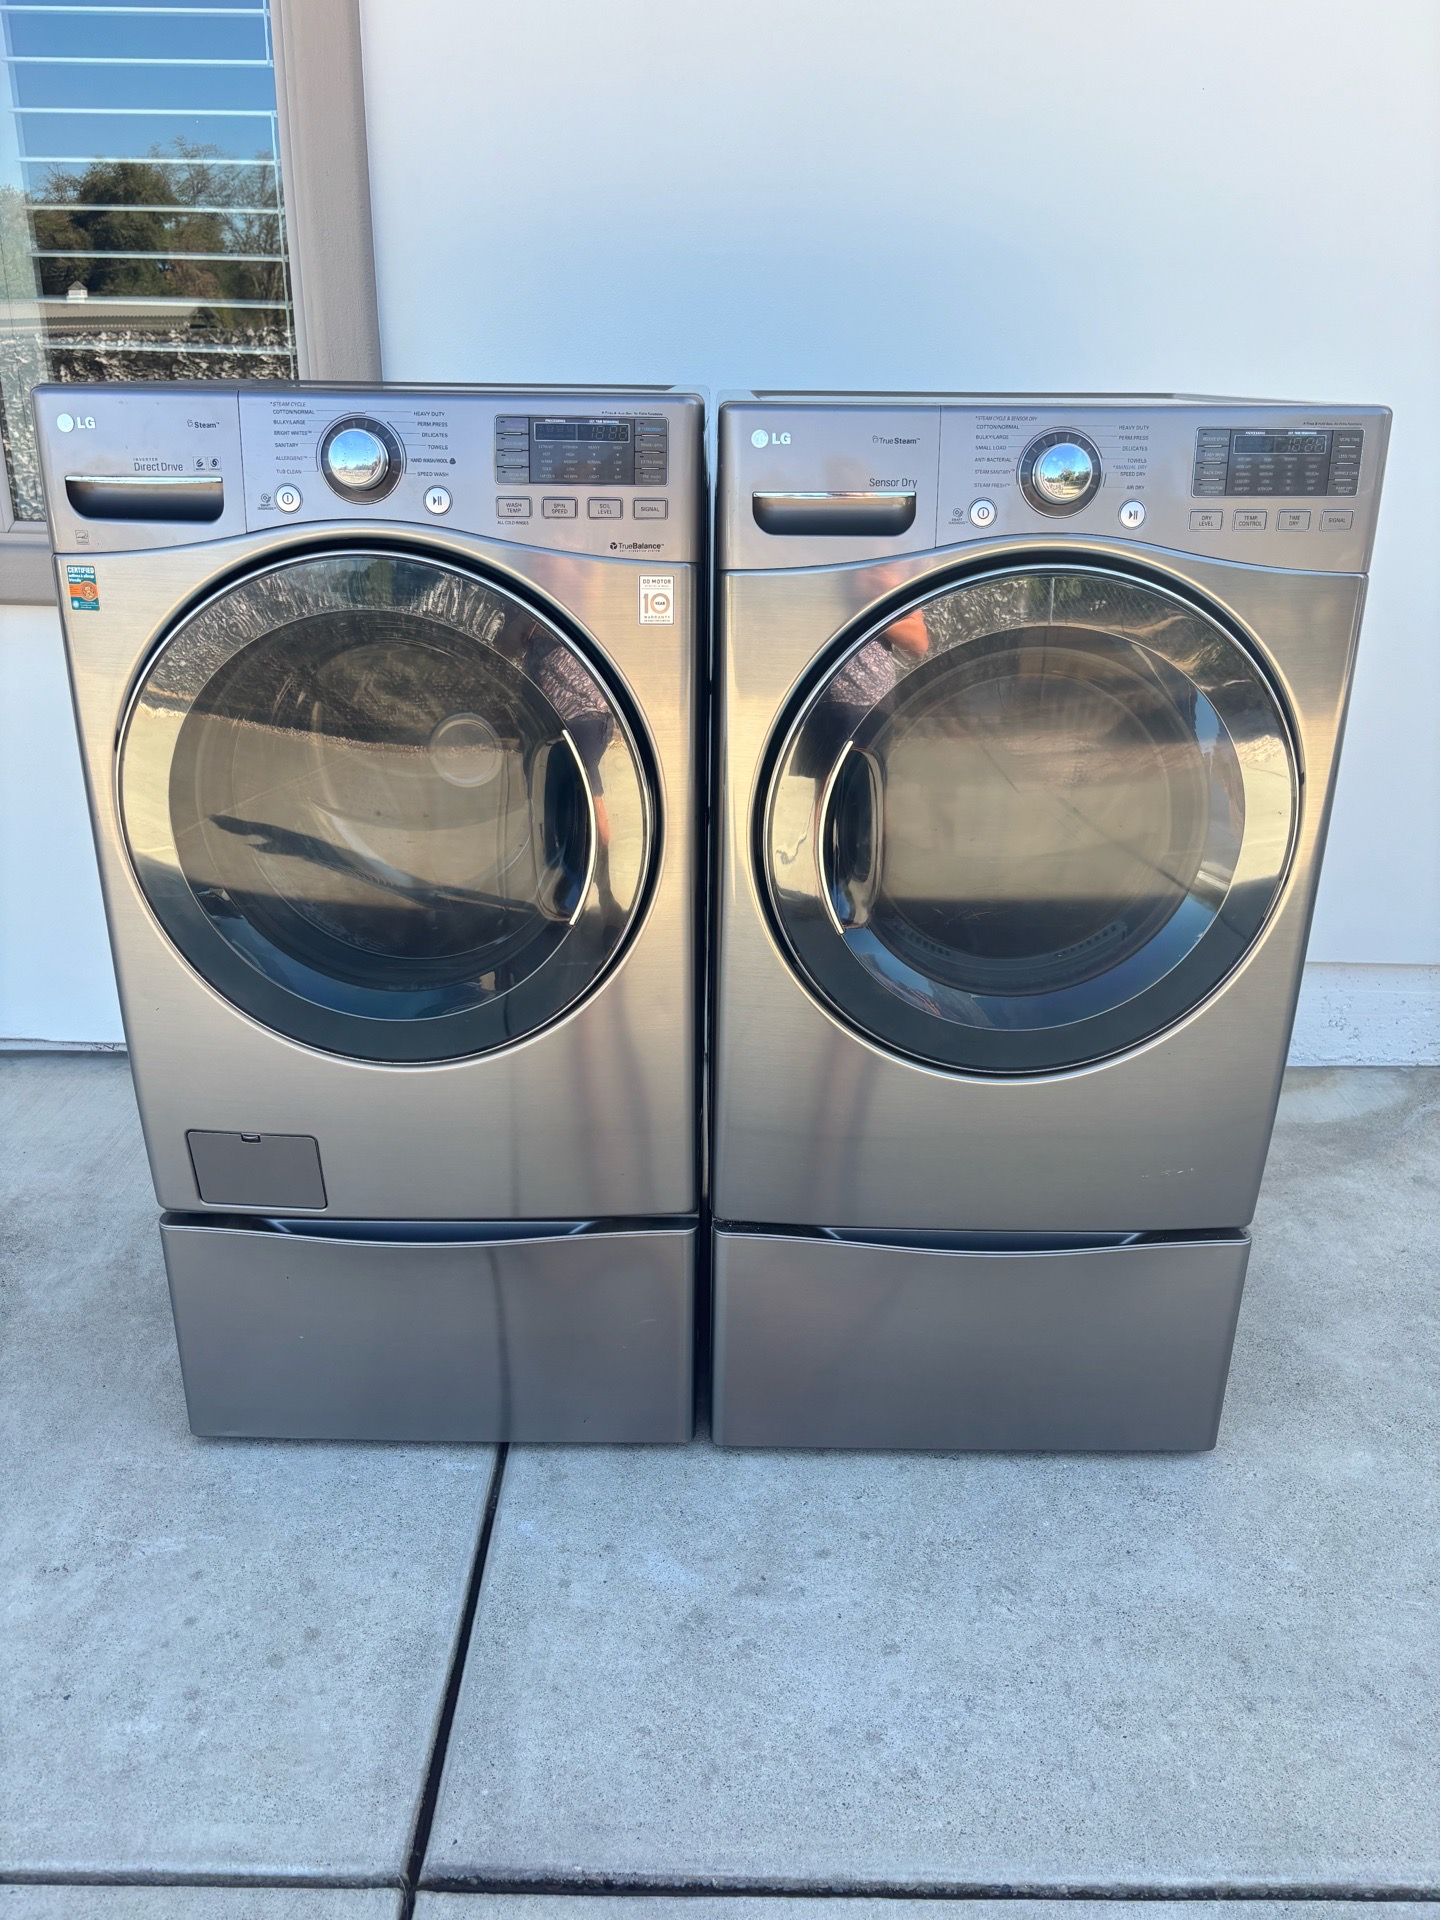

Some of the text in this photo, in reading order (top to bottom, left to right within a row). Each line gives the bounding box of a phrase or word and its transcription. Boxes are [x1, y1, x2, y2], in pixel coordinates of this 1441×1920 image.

[76, 416, 96, 429] LG
[771, 432, 791, 445] LG
[869, 478, 918, 489] Sensor Dry
[67, 566, 95, 574] CERTIFIED
[643, 592, 671, 615] 10
